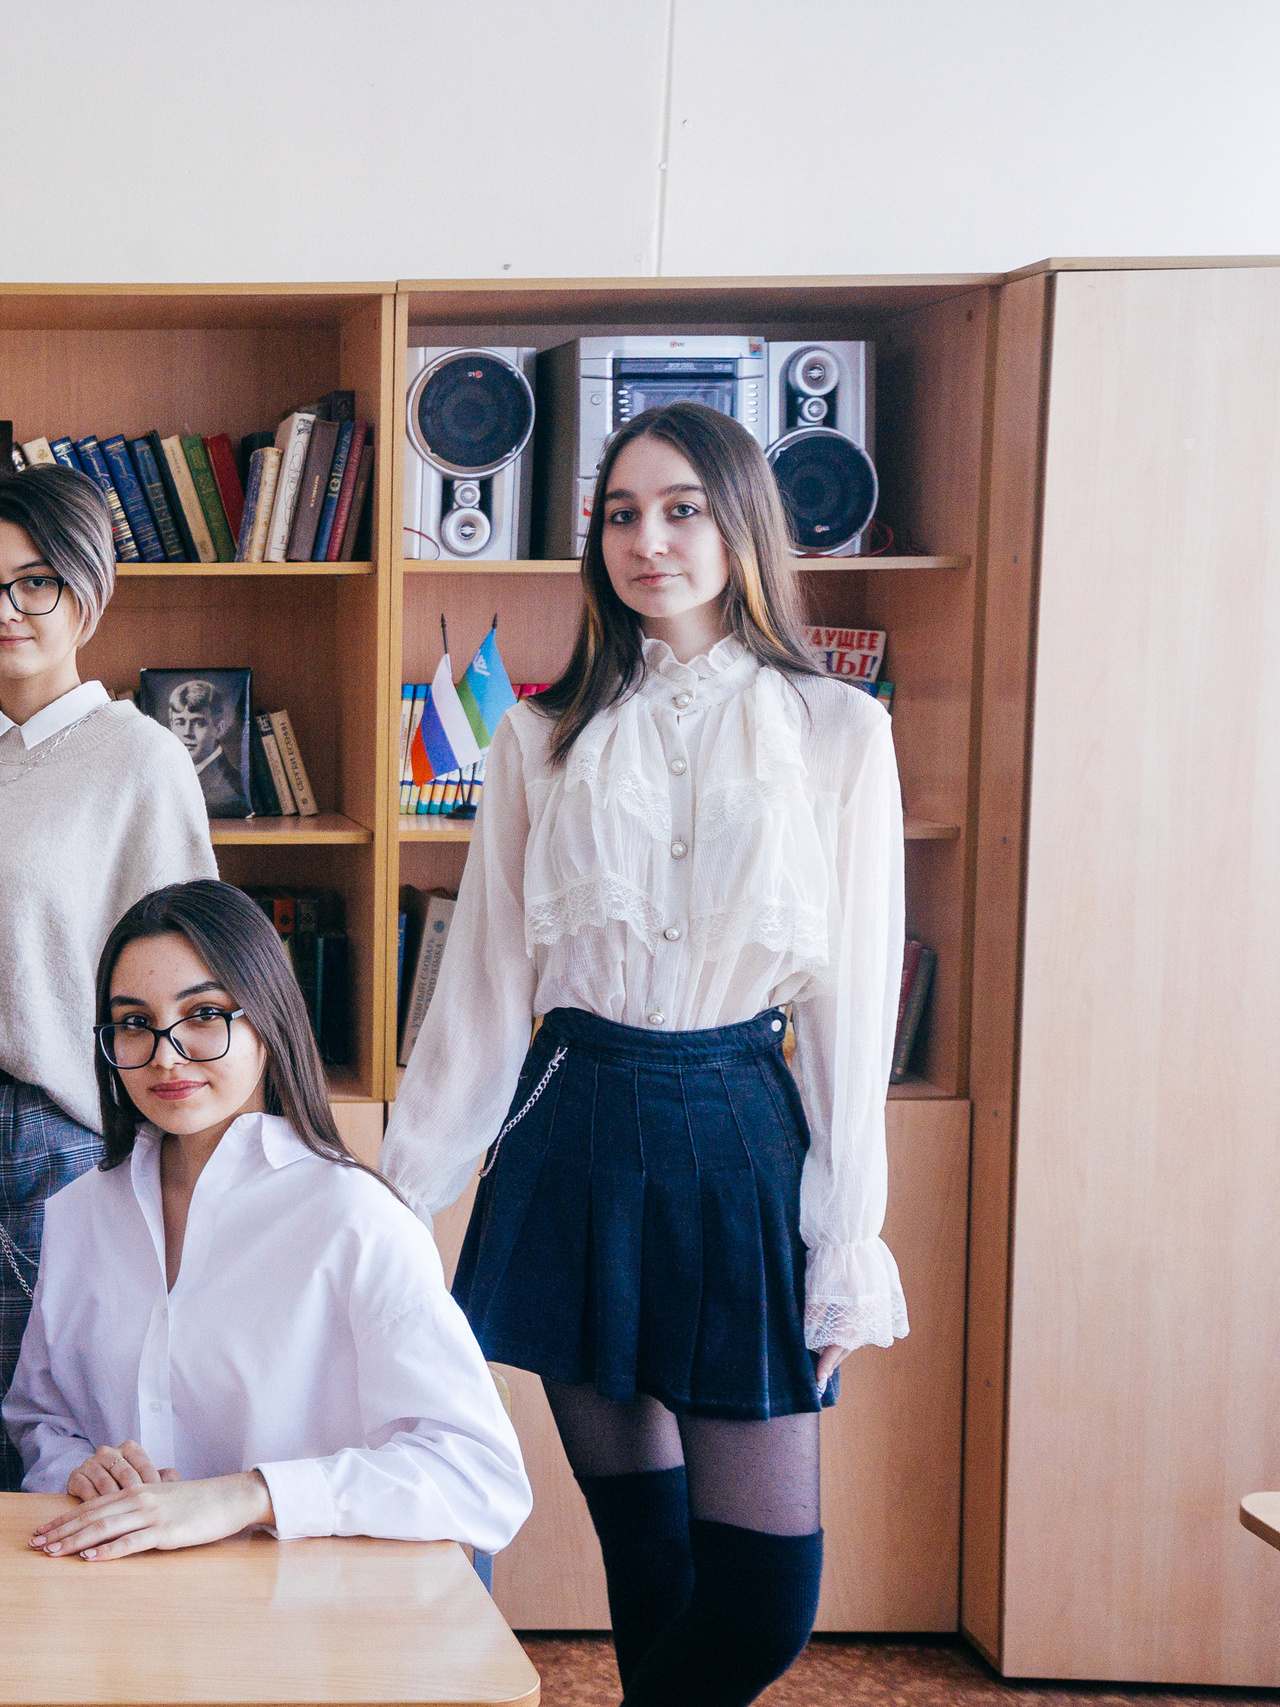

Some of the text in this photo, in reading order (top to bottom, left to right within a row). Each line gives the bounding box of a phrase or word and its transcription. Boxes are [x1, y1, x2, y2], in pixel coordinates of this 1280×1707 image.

[803, 628, 879, 651] ДУЩЕЕ
[279, 721, 304, 791] СЕРГЕЙ ЕСЕНИН
[410, 937, 435, 1029] УЧЕБНЫЙ СЛОВАРЬ
[430, 943, 443, 975] ЯЗЫКА
